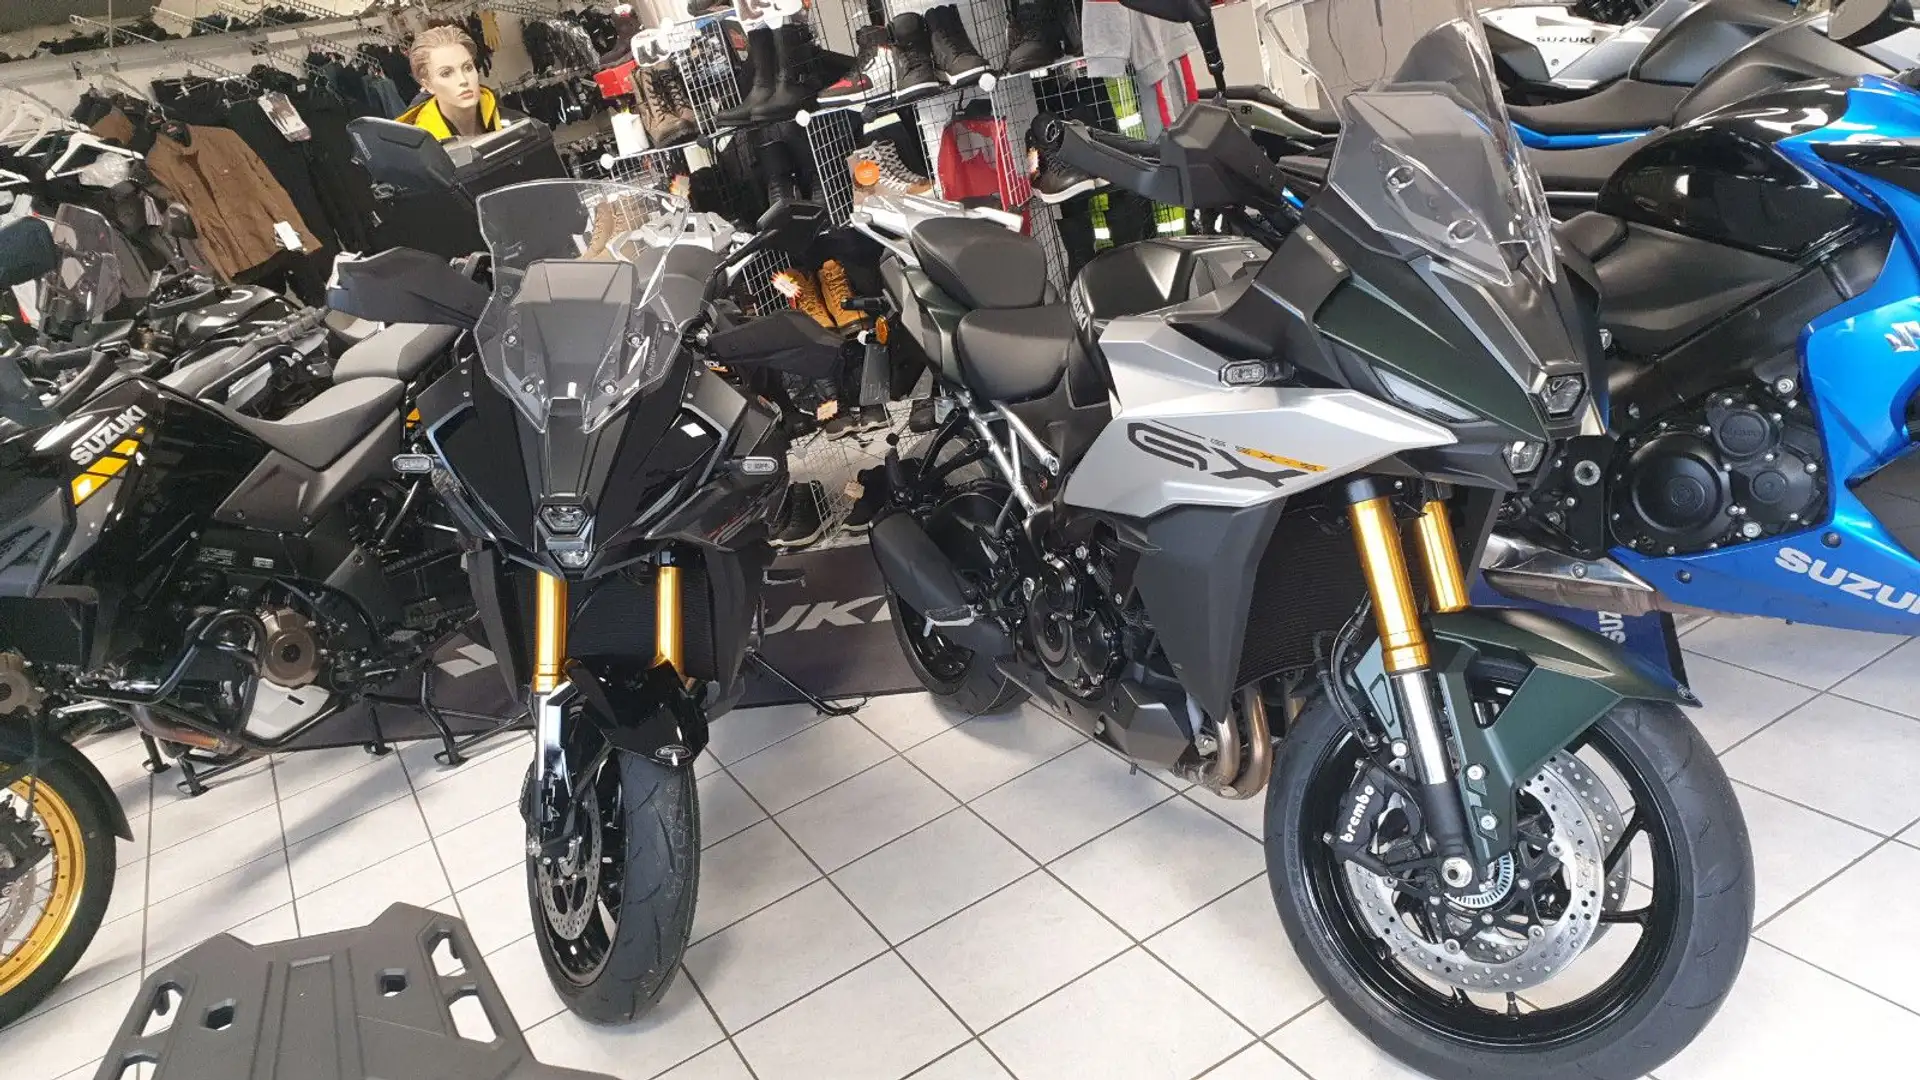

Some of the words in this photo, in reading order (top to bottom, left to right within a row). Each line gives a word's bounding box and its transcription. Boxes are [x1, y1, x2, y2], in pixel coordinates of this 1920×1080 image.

[1536, 36, 1596, 44] SUZUKI
[70, 404, 148, 466] SUZUKI
[1339, 784, 1375, 843] brembo
